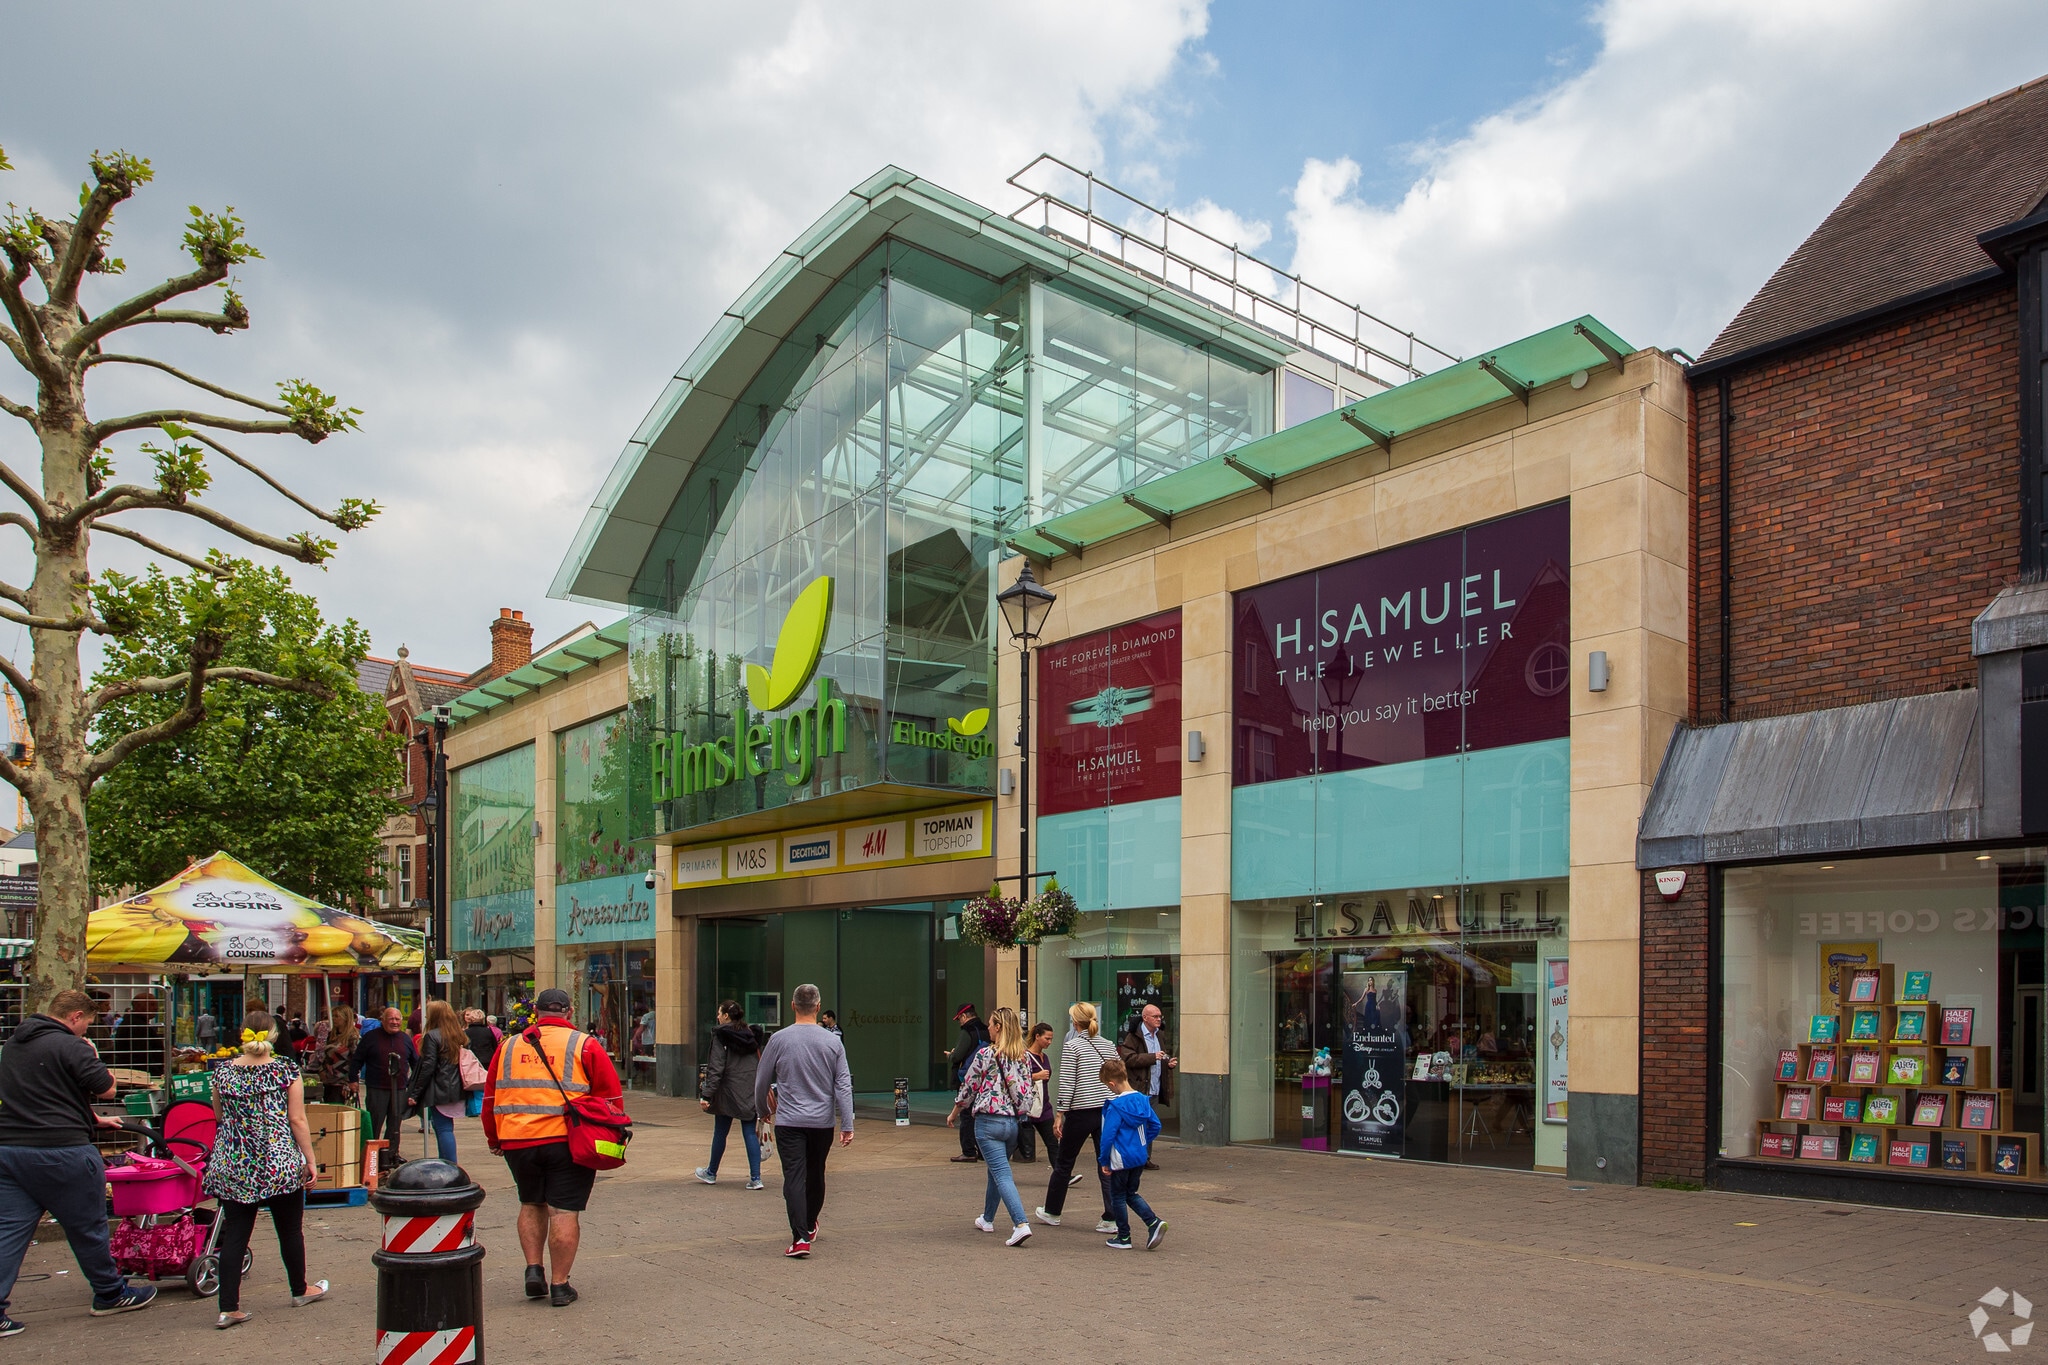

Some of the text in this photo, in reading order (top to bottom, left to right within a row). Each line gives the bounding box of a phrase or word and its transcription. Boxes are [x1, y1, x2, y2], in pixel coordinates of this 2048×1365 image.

[1276, 569, 1516, 659] H.SAMUEL
[1049, 629, 1176, 670] THE FOREVER DIAMOND
[1276, 622, 1514, 686] THE JEWELLER
[1069, 667, 1088, 677] FLOWER
[1131, 650, 1152, 660] SPARKLE
[1302, 688, 1479, 734] help you say it better
[650, 677, 847, 803] Elmsleigh
[892, 720, 995, 761] Elmsleigh
[1077, 749, 1142, 773] H.SAMUEL
[1077, 766, 1141, 782] THE JEWELLER
[923, 816, 973, 835] TOPMAN
[791, 844, 828, 860] DECATHLON
[862, 828, 888, 858] H&M
[923, 833, 973, 852] TOPSHOP
[680, 859, 718, 873] PRIMARK
[736, 847, 767, 871] M&S
[192, 902, 283, 910] COUSINS
[568, 884, 650, 937] Accessorize
[1295, 889, 1560, 936] H.SAMUEL
[226, 950, 276, 958] COUSINS
[1551, 995, 1567, 1007] HALF
[847, 1008, 922, 1028] Accessorize
[1353, 1031, 1395, 1043] Enchanted
[1893, 1059, 1917, 1069] Alien
[1869, 1100, 1892, 1110] Alien
[1966, 1100, 1990, 1108] PRICE
